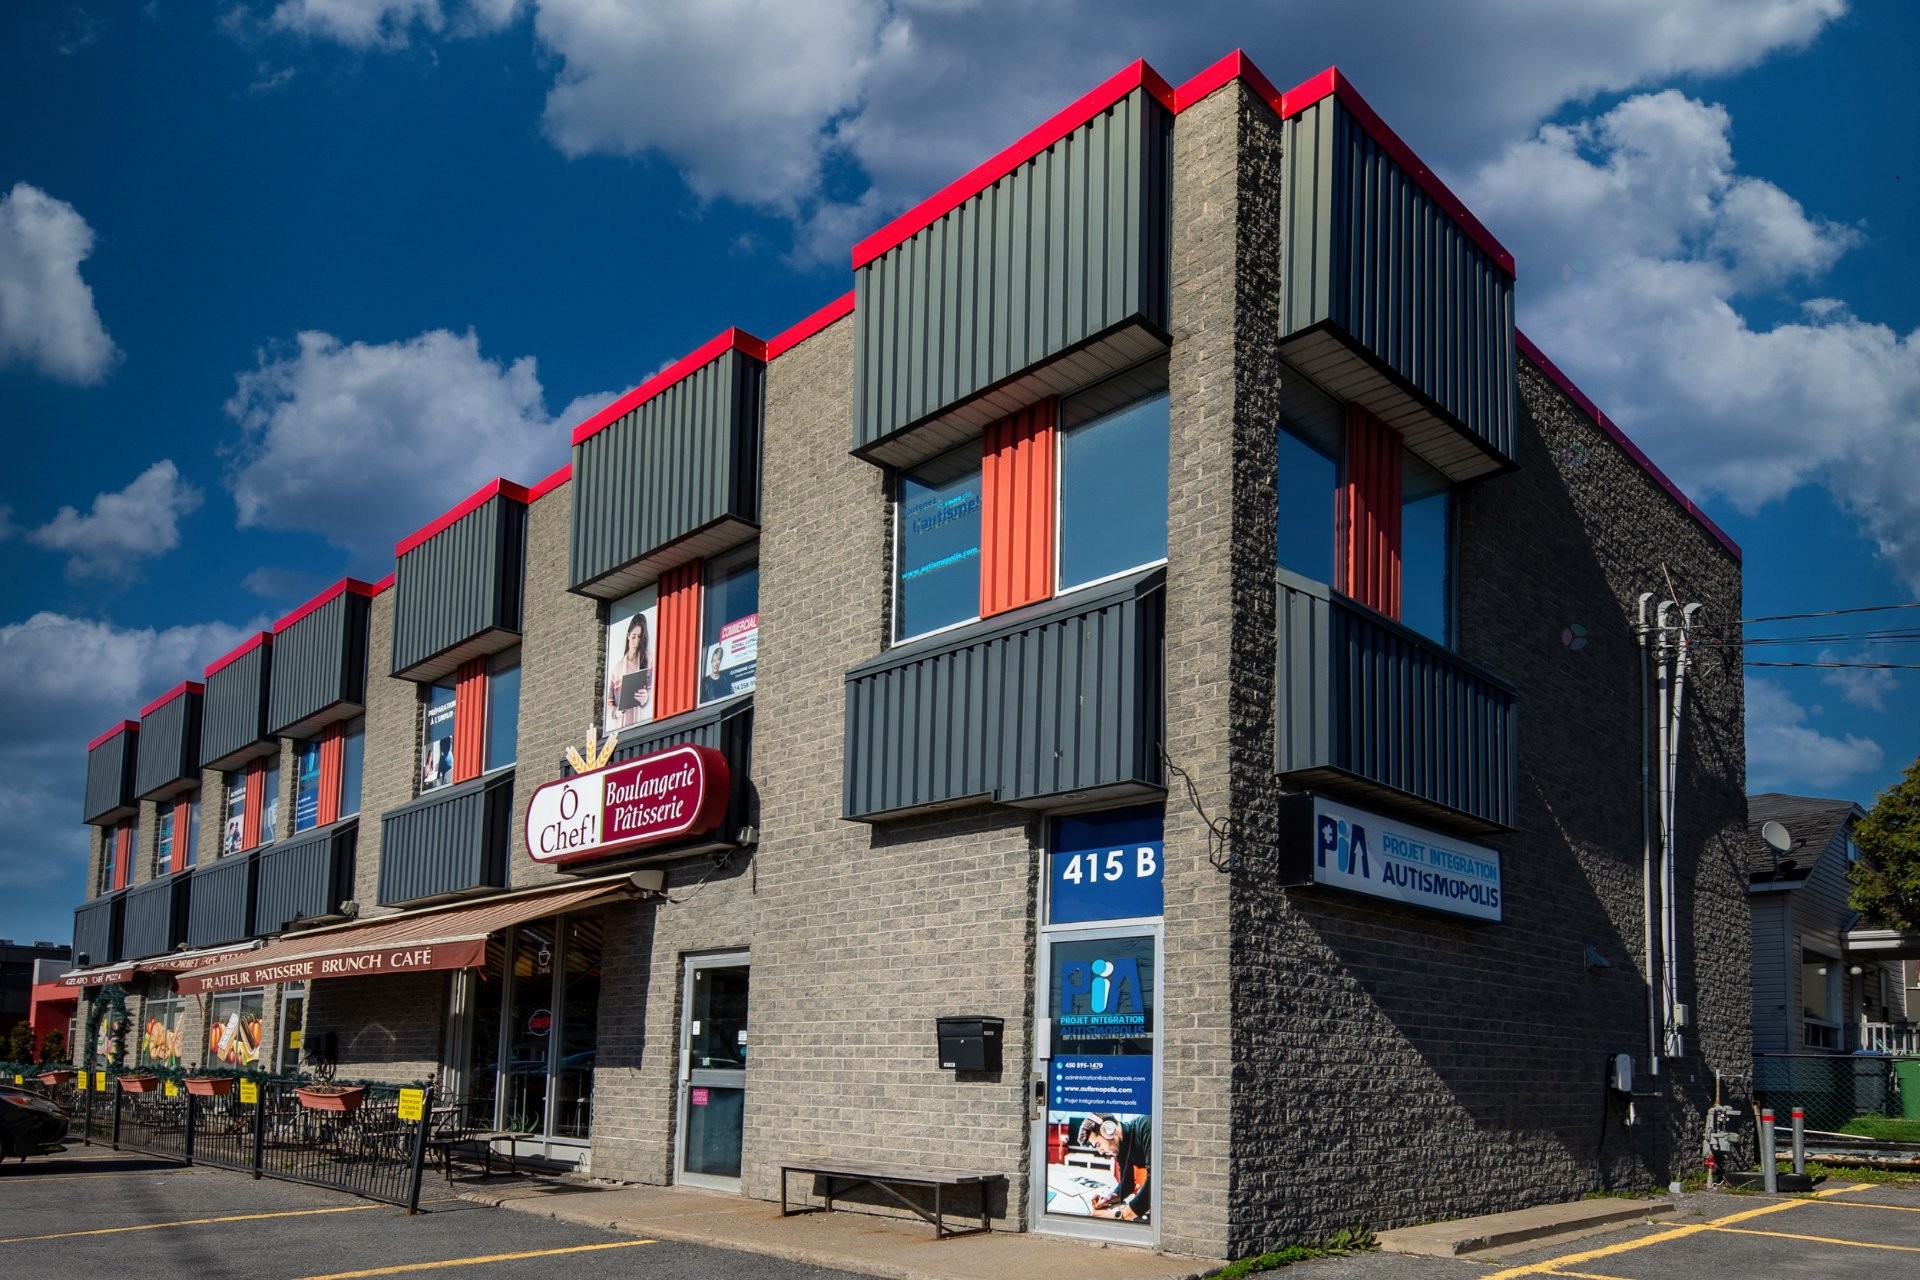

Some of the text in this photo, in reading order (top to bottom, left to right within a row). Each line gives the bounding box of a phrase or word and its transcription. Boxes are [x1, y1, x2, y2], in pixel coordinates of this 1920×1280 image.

[721, 616, 757, 639] COMMERCIAL
[560, 784, 579, 820] Ô
[606, 762, 695, 806] Boulangerie
[613, 795, 684, 832] Pâtisserie
[540, 814, 597, 853] Chef!
[1063, 847, 1157, 885] 415 B
[1382, 834, 1497, 881] PROJET INTEGRATION
[1382, 861, 1499, 908] AUTISMOPOLIS
[200, 946, 432, 990] TRAITEUR PATISSERIE BRUNCH CAFÉ
[1060, 1015, 1145, 1025] PROJET INTEGRATION
[1060, 1025, 1145, 1036] AUTISMOPOLIS
[1064, 1085, 1133, 1094] www.autismopolis.com
